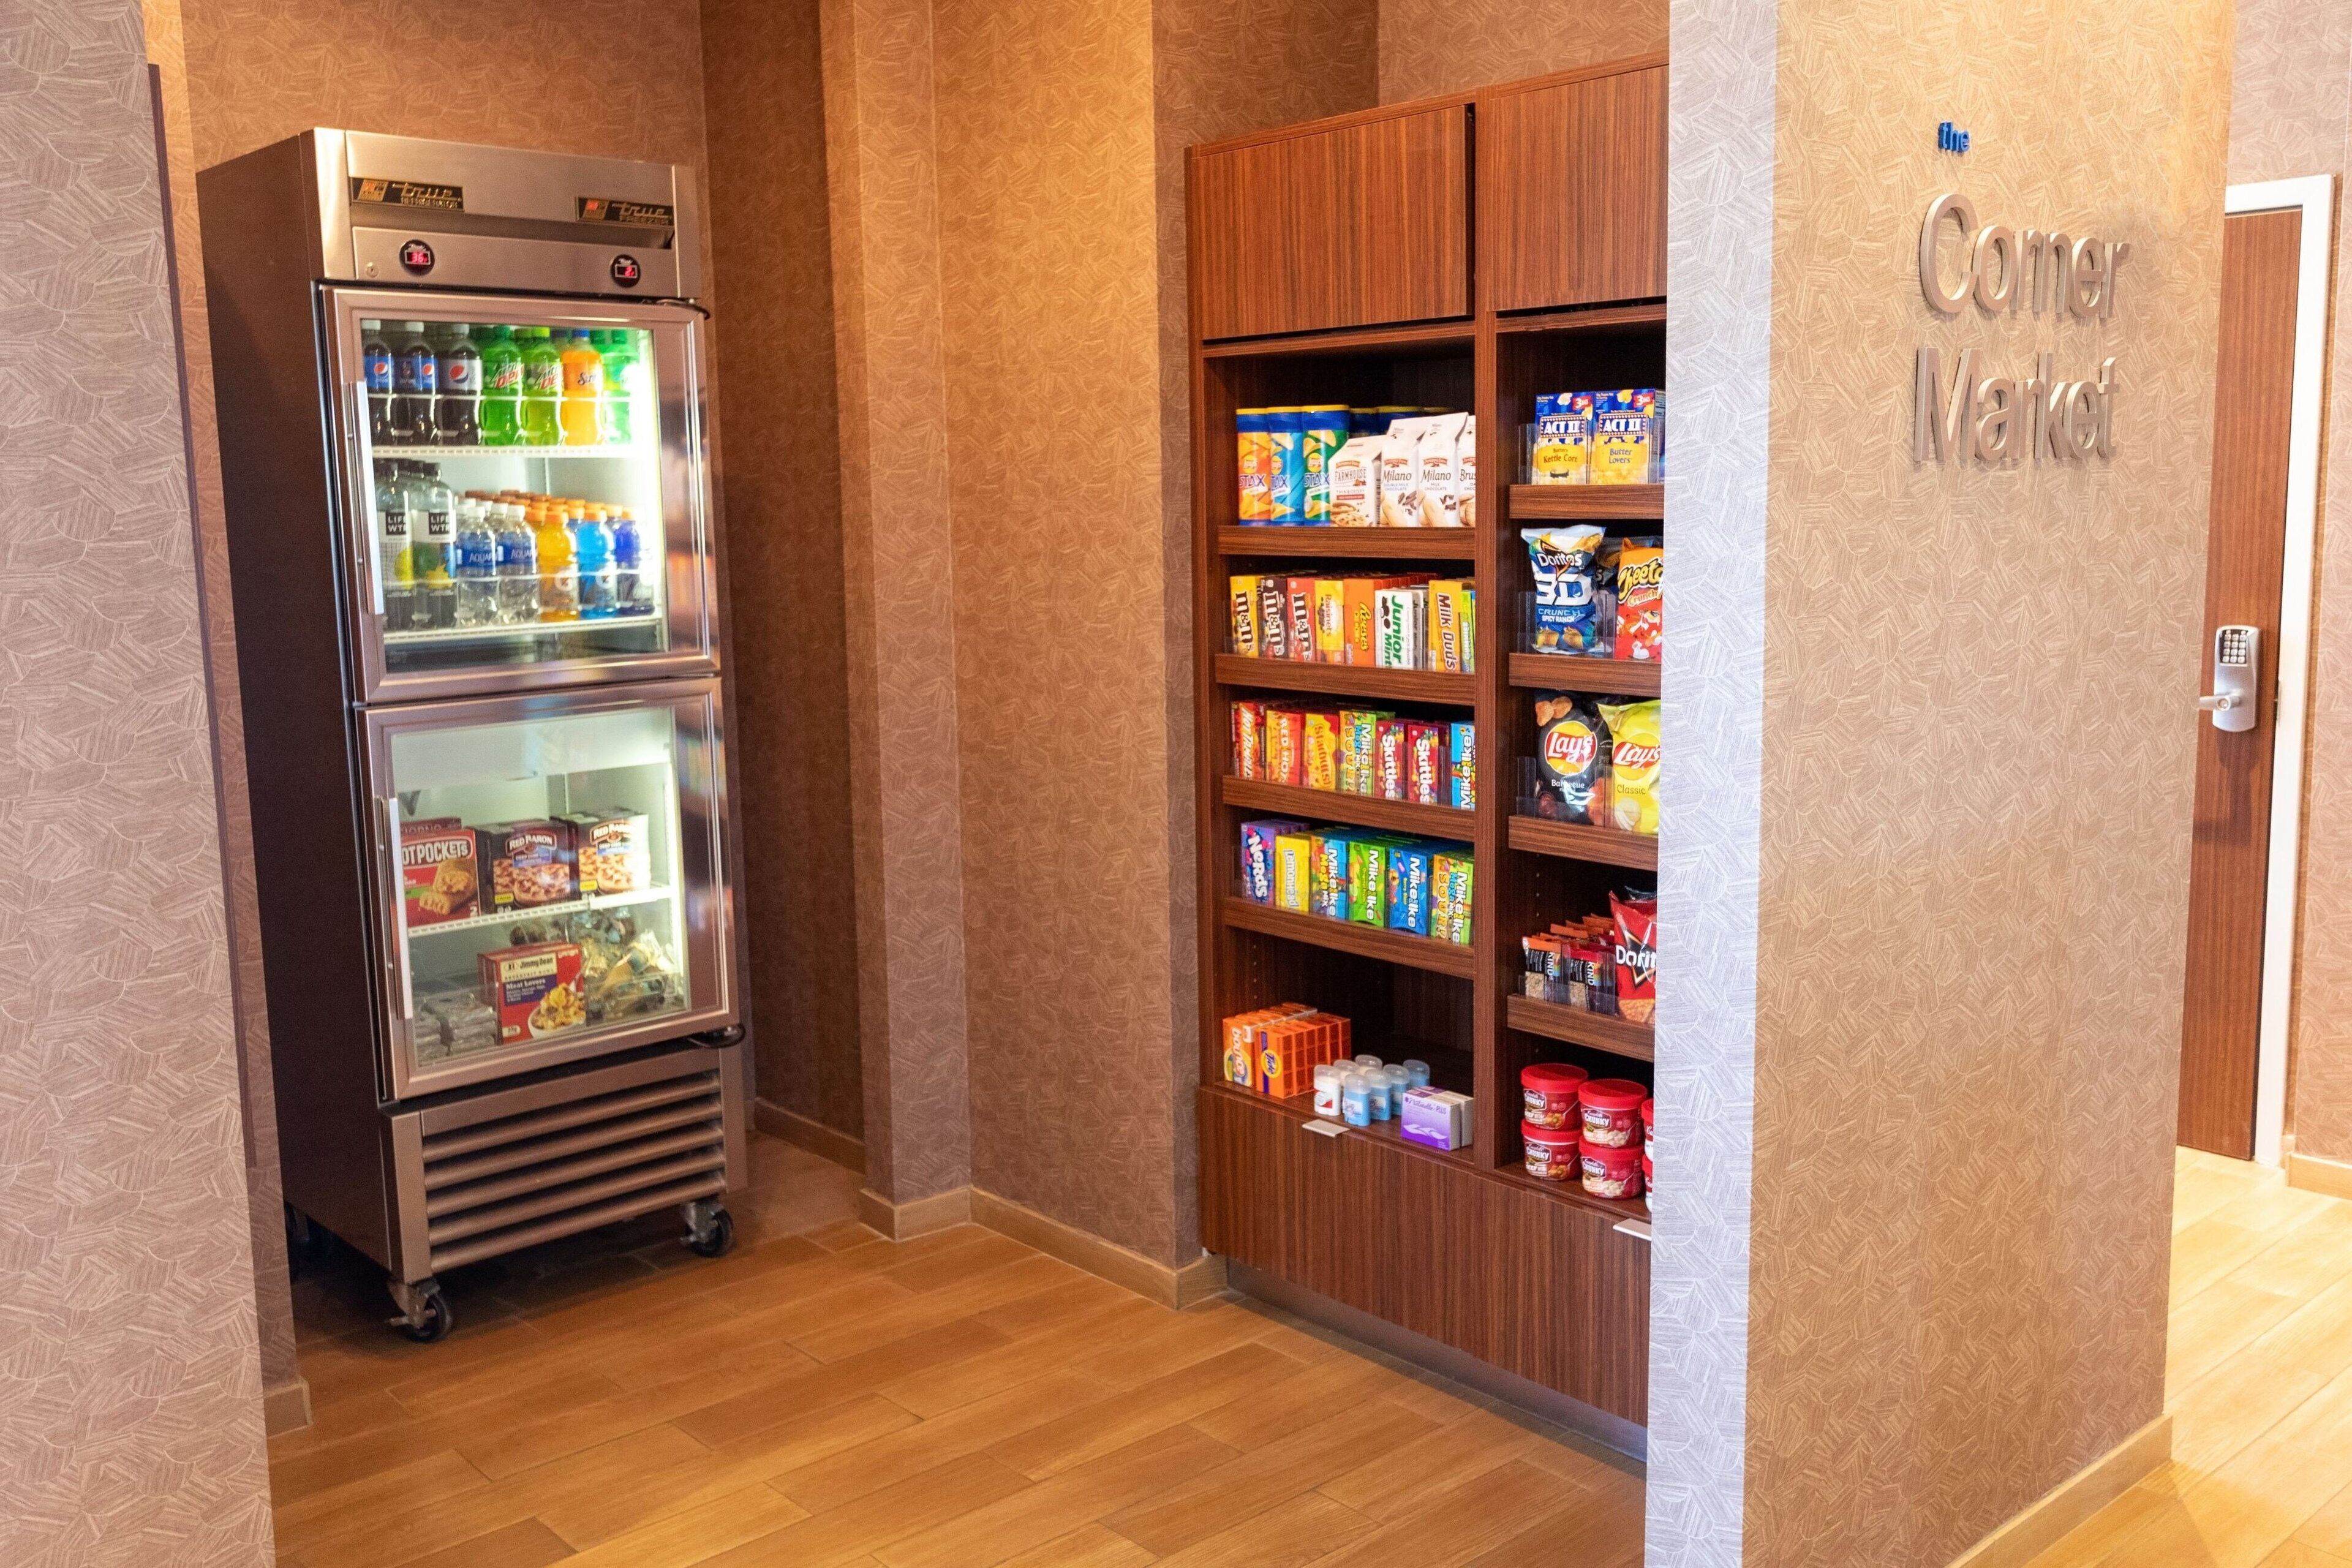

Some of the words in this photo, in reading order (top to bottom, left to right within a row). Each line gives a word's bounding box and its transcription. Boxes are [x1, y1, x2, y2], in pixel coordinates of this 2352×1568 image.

[1938, 121, 1970, 152] the
[1920, 194, 2130, 318] Corner
[1913, 347, 2119, 460] Market
[1544, 421, 1567, 434] ACT
[1568, 420, 1580, 432] II
[1603, 419, 1626, 432] ACT
[1628, 418, 1641, 431] II
[1544, 455, 1561, 464] Kettle
[1238, 474, 1265, 488] STAX
[1272, 475, 1288, 488] TAX
[1335, 469, 1366, 481] FARMHOUSE
[1382, 470, 1412, 482] Milano
[1422, 470, 1451, 482] Milano
[1536, 553, 1582, 567] Doritos
[1618, 558, 1664, 601] Cheeto
[1438, 593, 1452, 627] Milk
[1392, 595, 1404, 664] Junior
[1384, 633, 1393, 668] Mint
[1442, 630, 1456, 670] Duds
[1360, 723, 1373, 765] Mike
[1547, 733, 1594, 763] Lay's
[1382, 735, 1397, 800] Skittles
[1416, 739, 1433, 804] Skittles
[1460, 766, 1471, 809] Mike
[1617, 785, 1646, 795] Classic
[402, 846, 417, 865] OT
[416, 840, 469, 865] POCKETS
[1328, 848, 1338, 888] Mike
[1368, 850, 1379, 892] Mike
[1409, 857, 1420, 899] Mike
[1329, 892, 1338, 916] Ike
[1455, 871, 1468, 914] Mike
[1366, 895, 1378, 920] Ike
[1408, 903, 1419, 928] Ike
[1452, 918, 1464, 944] Ike
[1547, 952, 1555, 976] KIND
[1616, 944, 1657, 968] Dorit
[1586, 962, 1596, 986] KIND
[1585, 1113, 1610, 1126] CHUNKY
[1526, 1146, 1549, 1160] CHUNKY
